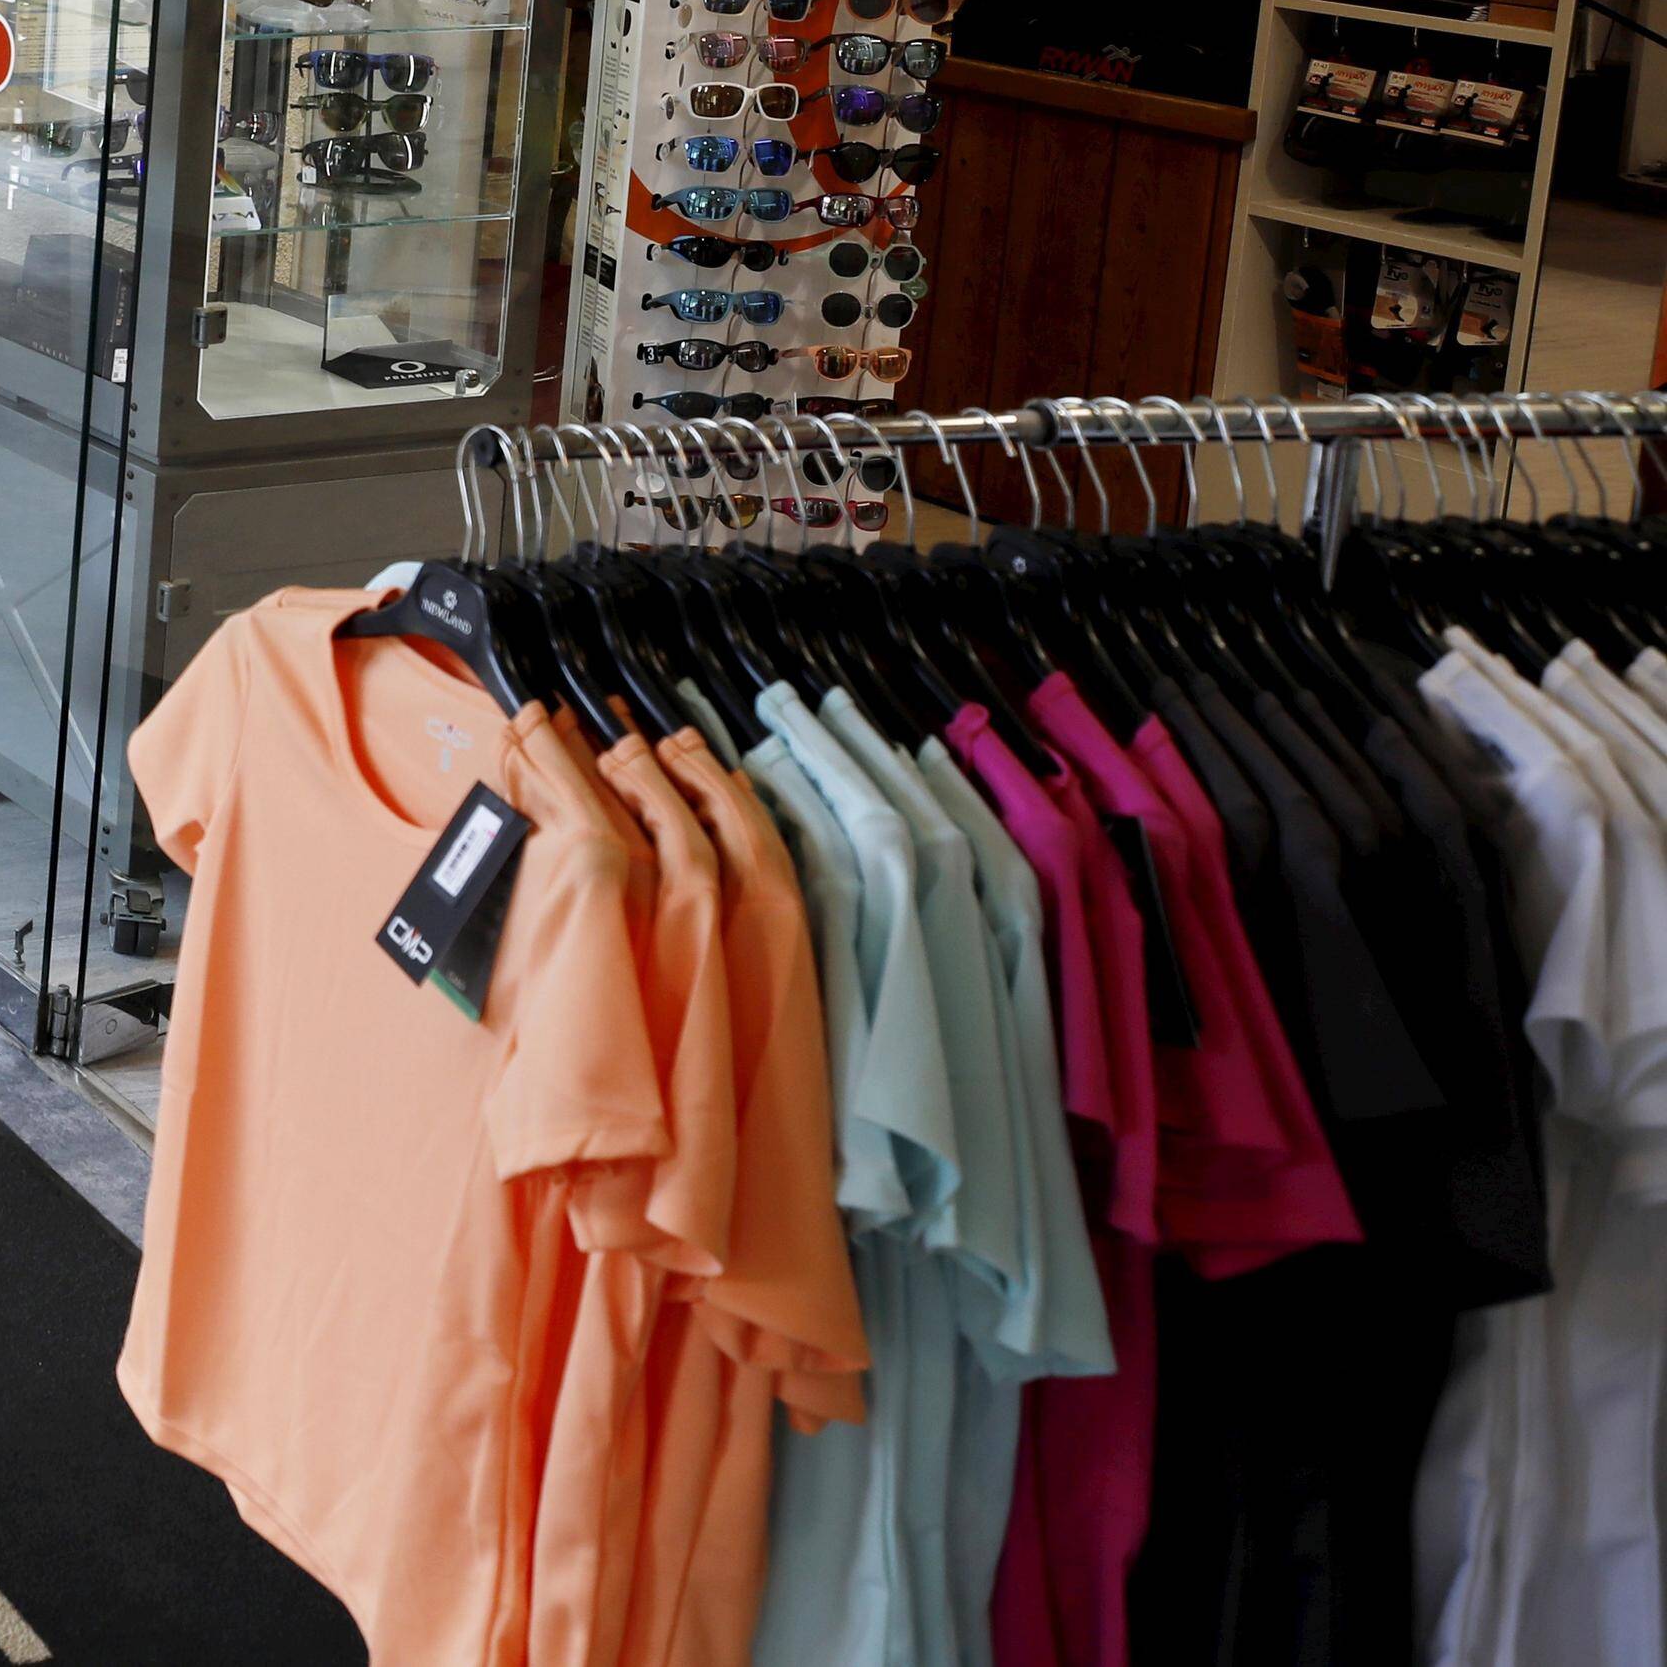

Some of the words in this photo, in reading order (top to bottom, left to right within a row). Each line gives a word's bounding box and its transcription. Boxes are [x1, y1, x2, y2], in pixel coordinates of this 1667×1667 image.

[647, 346, 655, 362] 3
[384, 370, 450, 381] POLARIZED
[386, 915, 434, 965] CMP
